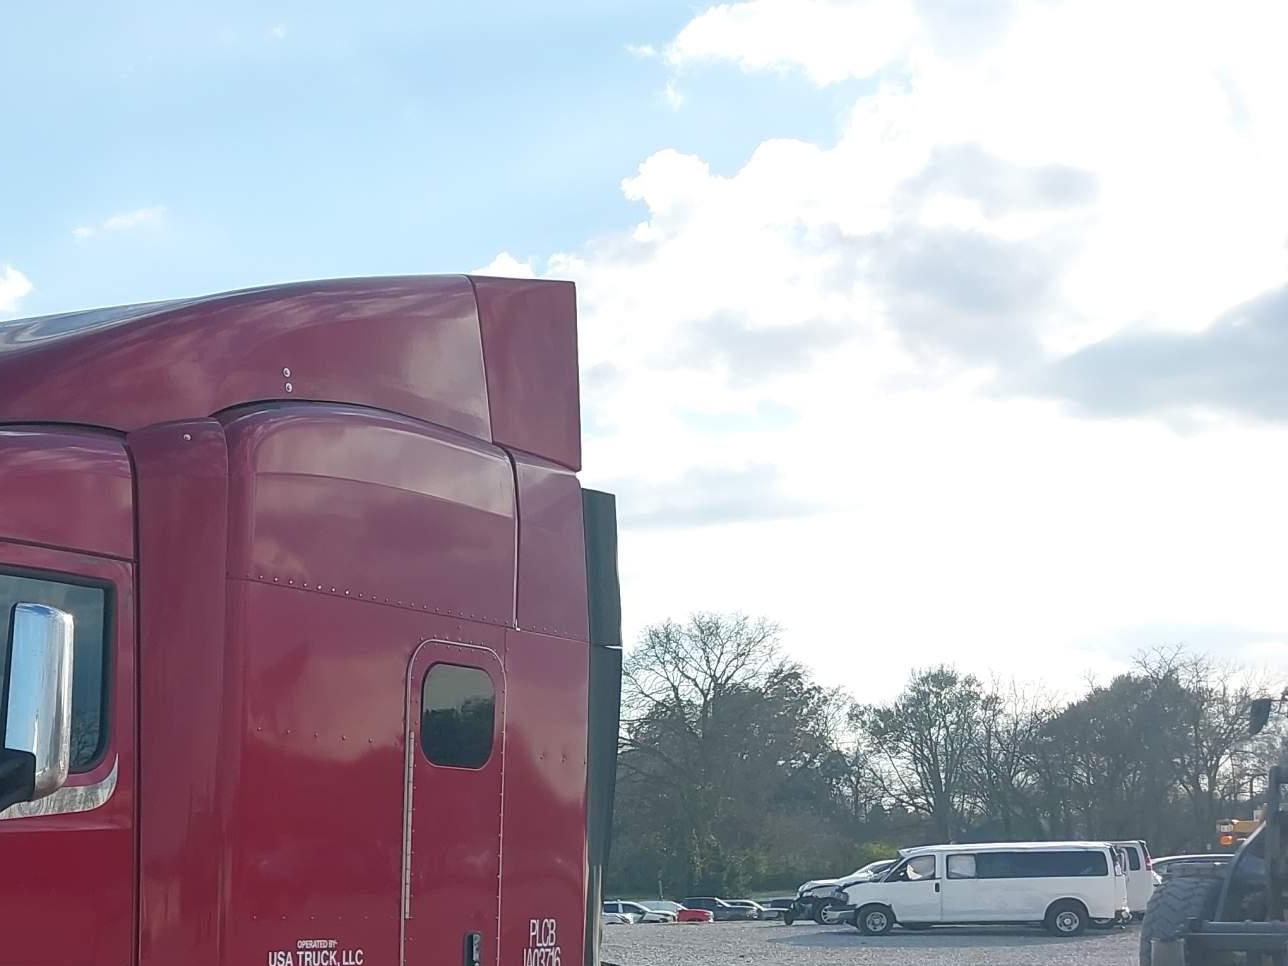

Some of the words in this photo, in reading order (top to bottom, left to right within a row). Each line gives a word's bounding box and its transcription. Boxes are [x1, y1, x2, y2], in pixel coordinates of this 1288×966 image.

[529, 918, 556, 947] PLCB
[297, 940, 328, 949] OPERATED
[342, 949, 364, 966] LLC
